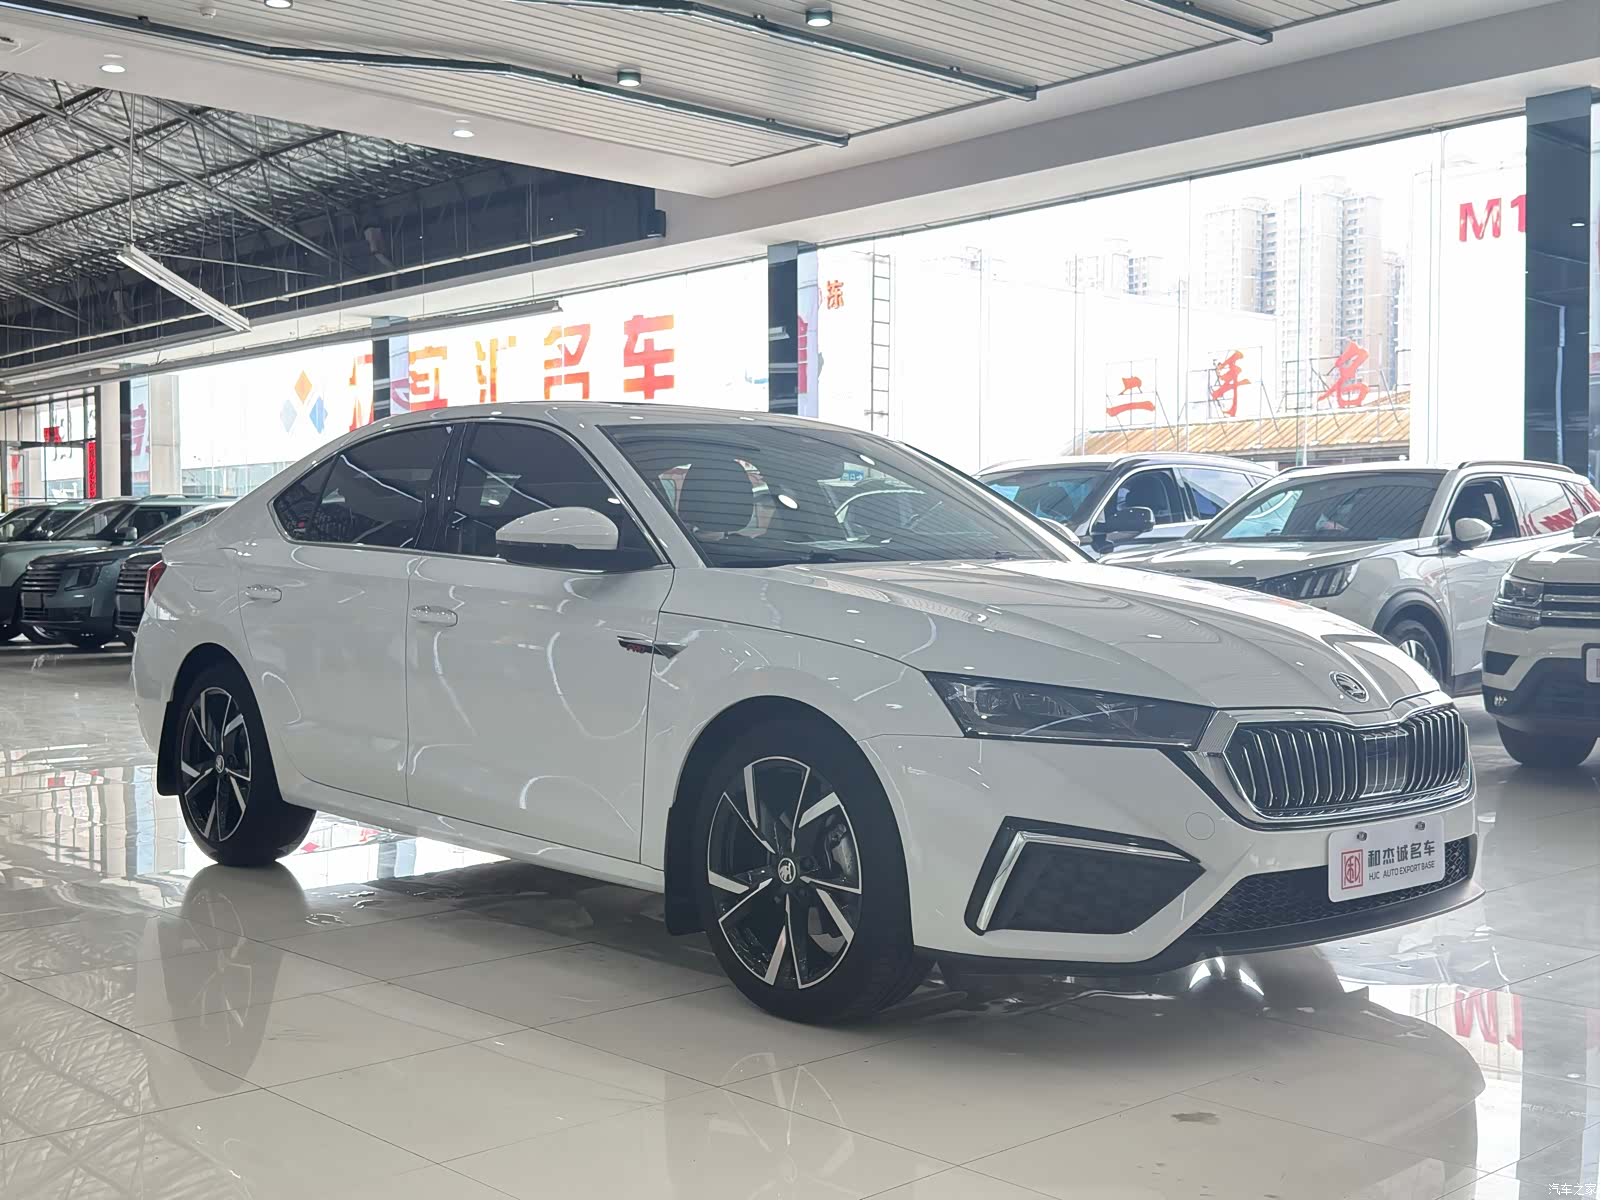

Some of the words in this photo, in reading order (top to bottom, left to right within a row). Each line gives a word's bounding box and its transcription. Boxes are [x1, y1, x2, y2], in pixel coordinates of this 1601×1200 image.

[1106, 339, 1369, 418] 二手名
[1368, 839, 1435, 868] 和杰诚名车
[1368, 871, 1380, 880] HJC
[1383, 867, 1399, 878] AUTO
[1400, 863, 1420, 875] EXPORT
[1421, 860, 1435, 871] BASE
